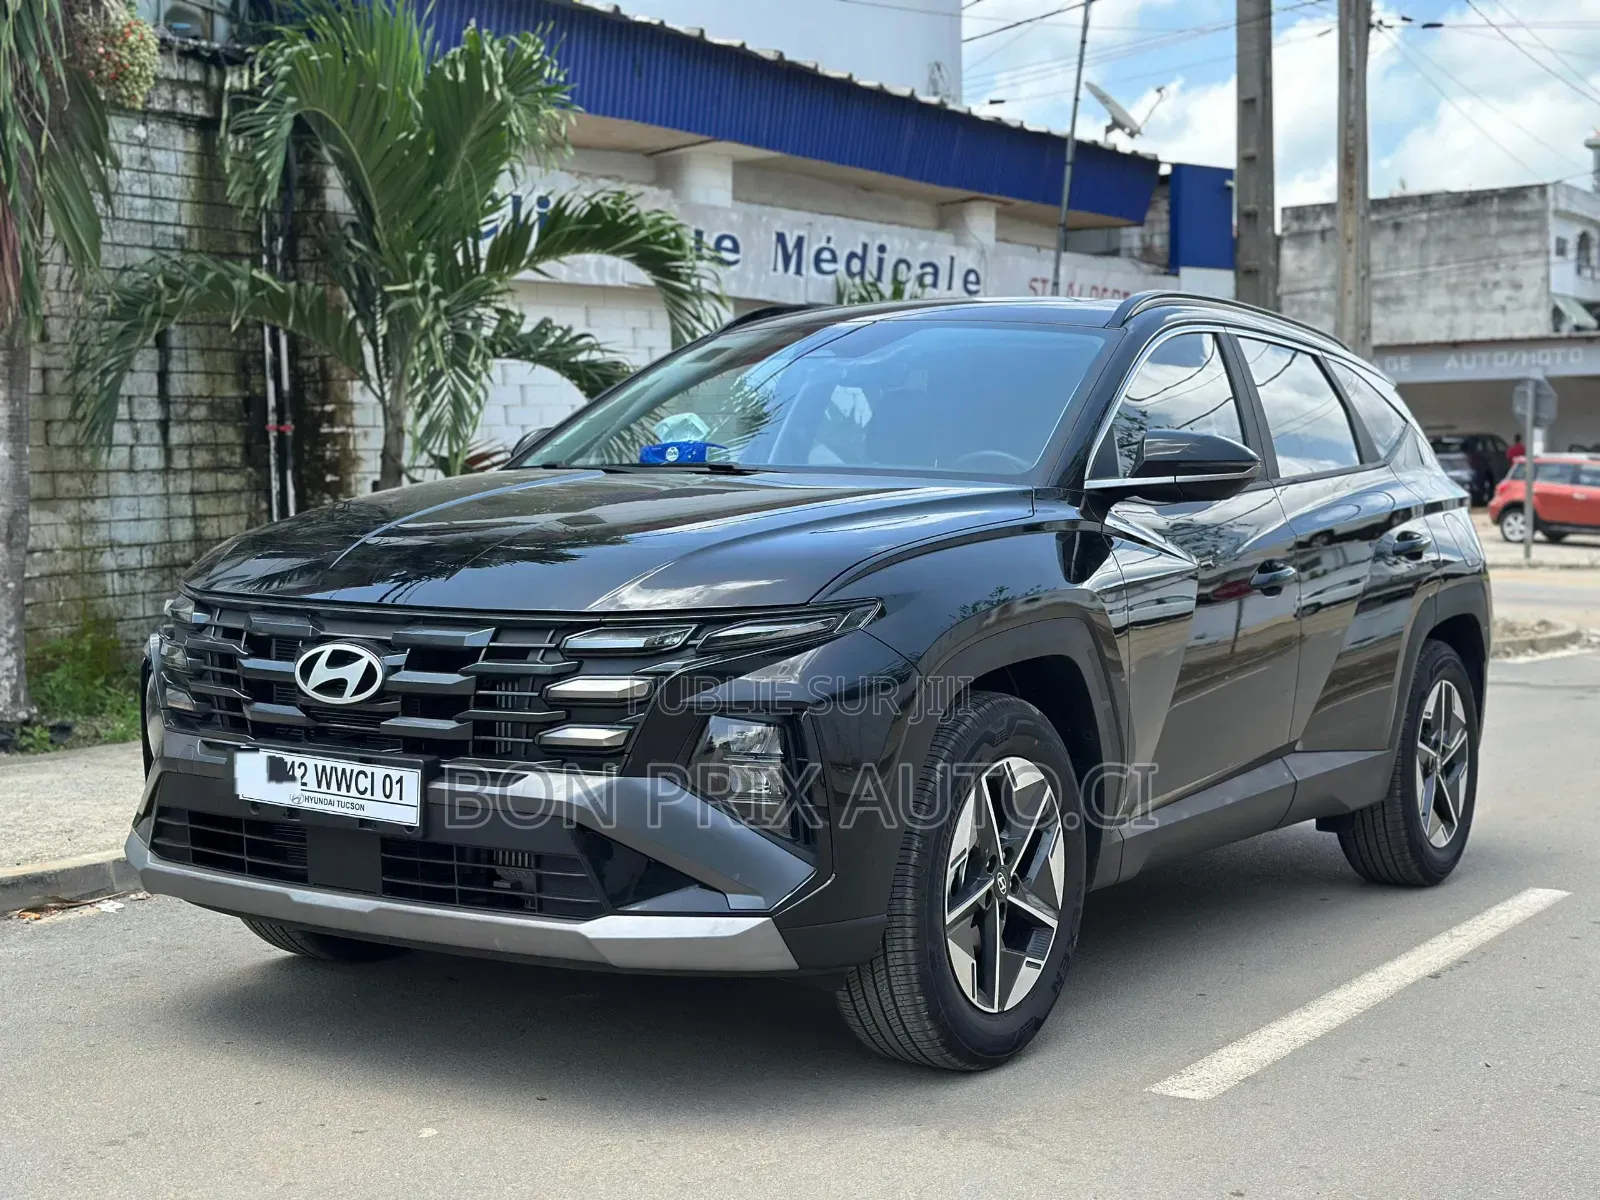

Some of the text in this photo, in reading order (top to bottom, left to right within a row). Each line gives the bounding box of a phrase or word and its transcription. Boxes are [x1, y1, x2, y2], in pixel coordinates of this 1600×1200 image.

[772, 231, 982, 295] Médicale
[1444, 347, 1584, 371] AUTO/MOTO
[314, 763, 375, 797] WWCI
[382, 773, 404, 801] 01
[304, 795, 365, 812] HYUNDAI TUCSON
